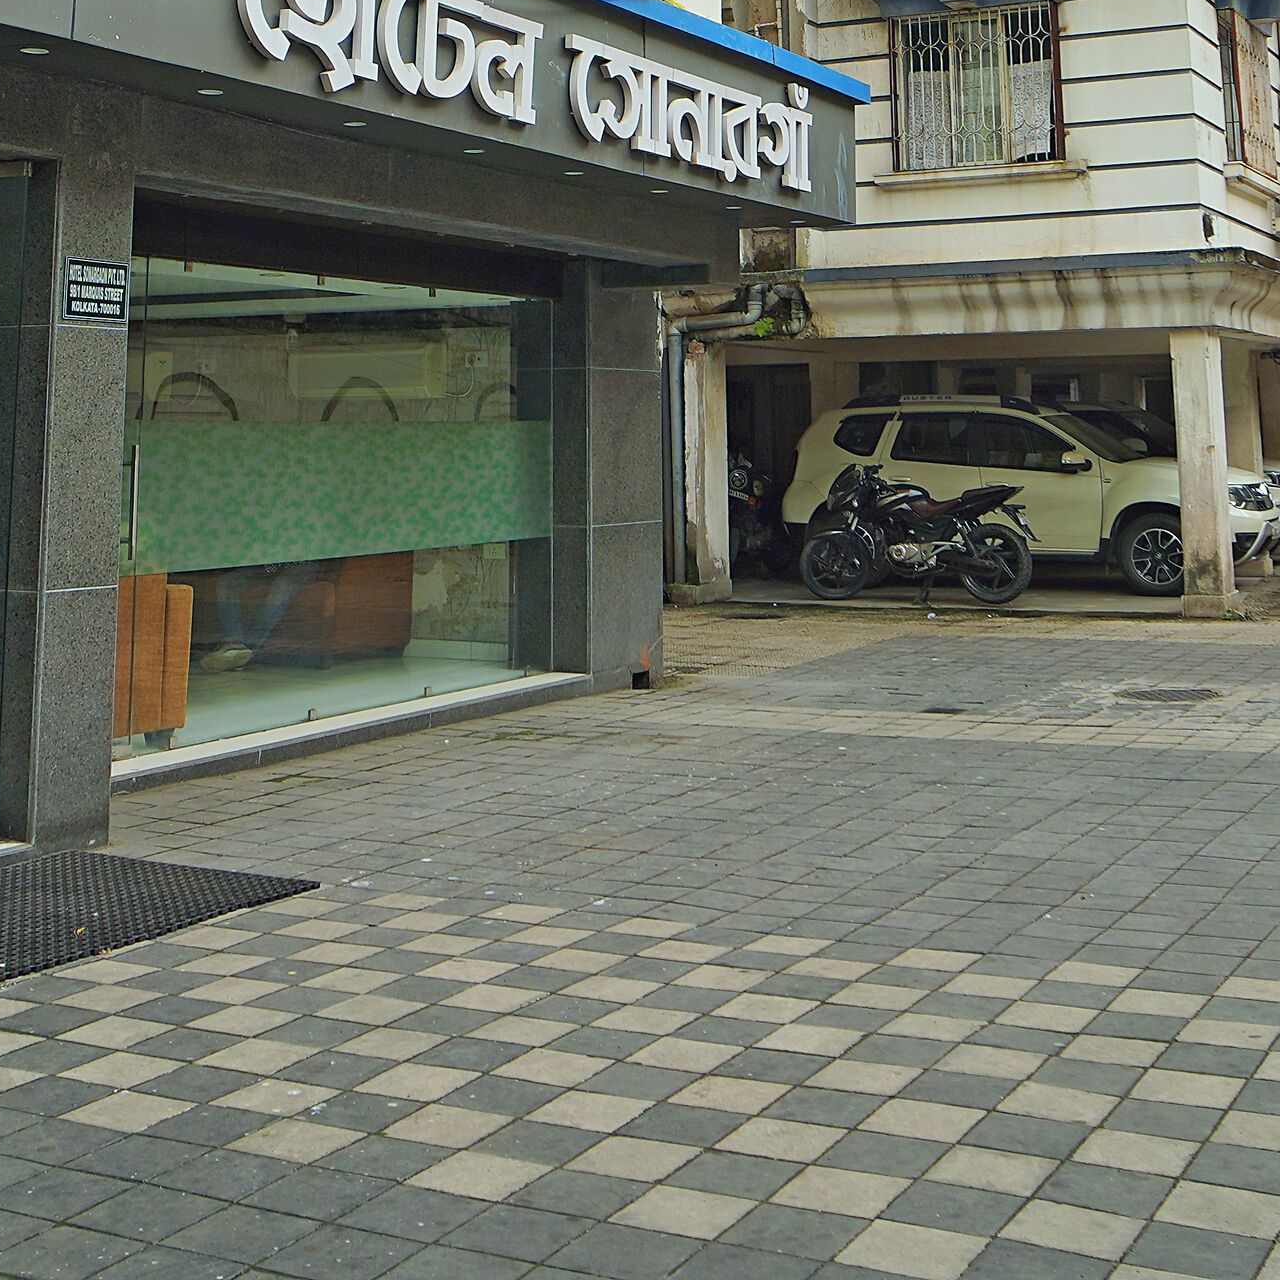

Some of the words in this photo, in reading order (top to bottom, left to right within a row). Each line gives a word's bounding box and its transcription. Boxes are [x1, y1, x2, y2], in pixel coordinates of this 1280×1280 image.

[564, 33, 813, 192] সোনারগাঁ
[69, 264, 82, 281] HOTEL
[81, 285, 104, 300] MARQUIS
[104, 287, 124, 302] STREET
